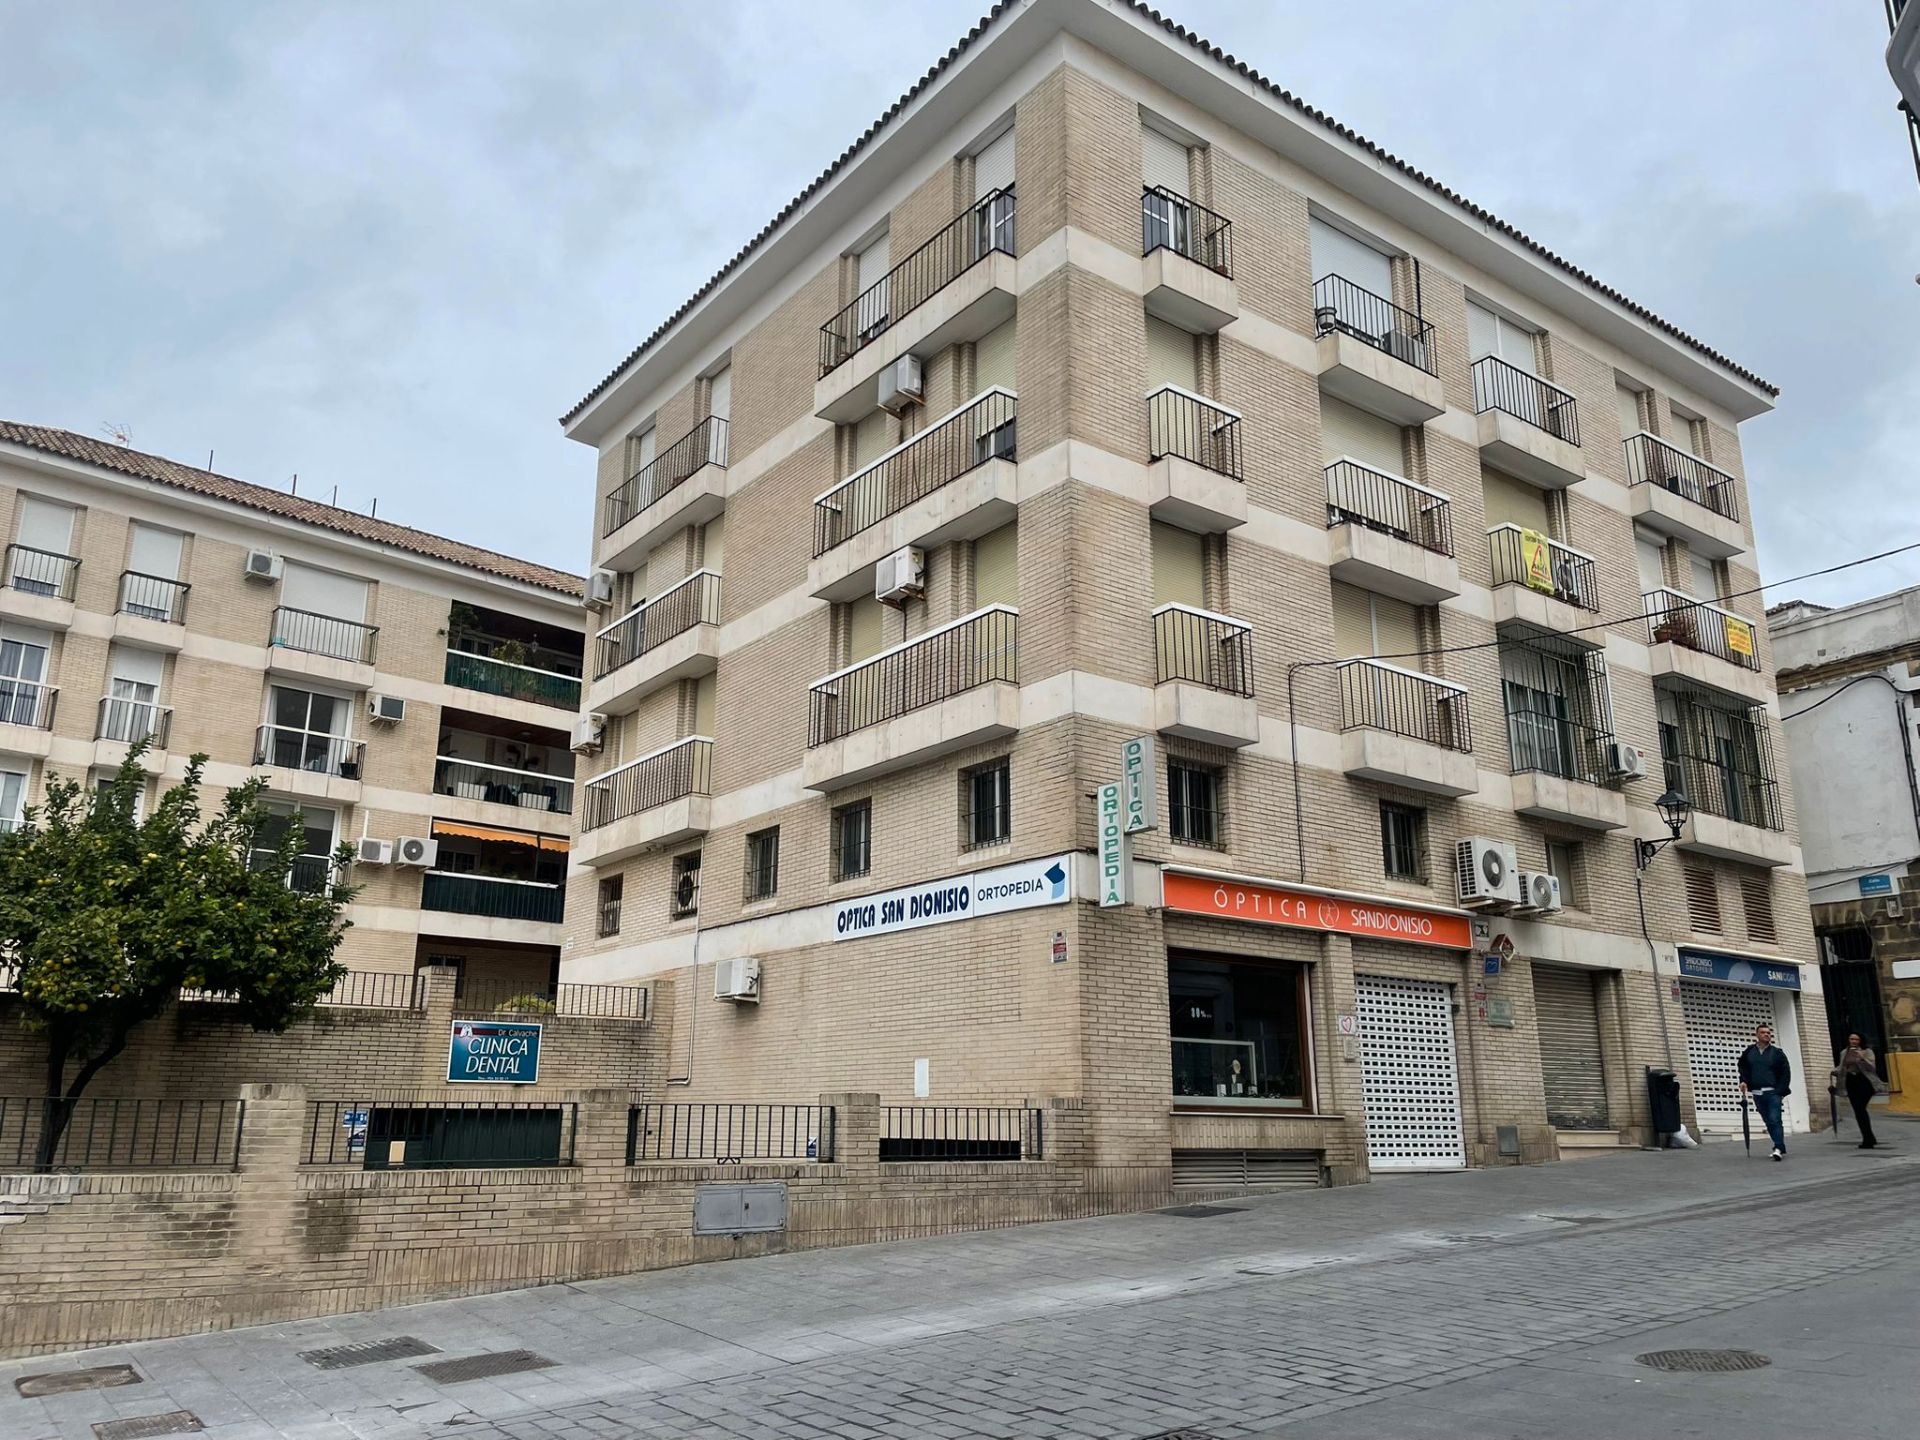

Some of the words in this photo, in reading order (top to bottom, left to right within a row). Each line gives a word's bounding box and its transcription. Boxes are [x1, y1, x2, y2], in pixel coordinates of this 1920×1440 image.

[1127, 742, 1143, 830] OPTICA
[1103, 785, 1120, 904] ORTOPEDIA
[837, 904, 875, 934] OPTICA
[881, 898, 905, 925] SAN
[910, 885, 970, 920] DIONISIO
[977, 877, 1044, 902] ORTOPEDIA
[1214, 884, 1308, 920] ÓPTICA
[1351, 908, 1433, 936] SANDIONISIO
[465, 1055, 520, 1074] DENTAL
[468, 1037, 528, 1056] CLINICA
